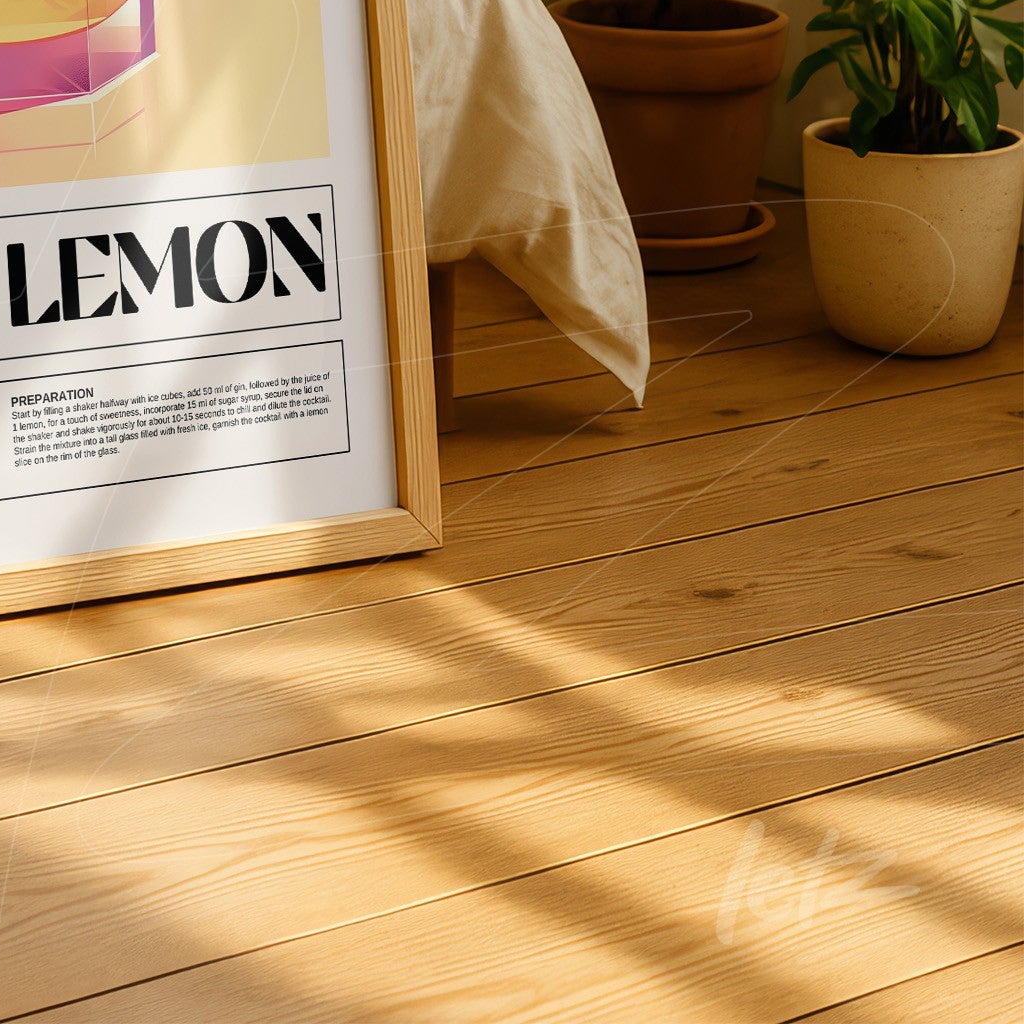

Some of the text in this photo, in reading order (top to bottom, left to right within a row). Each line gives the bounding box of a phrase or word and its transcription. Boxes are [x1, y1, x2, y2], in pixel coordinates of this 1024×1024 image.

[6, 212, 326, 327] LEMON
[11, 388, 94, 407] PREPARATION
[12, 410, 30, 419] Start
[33, 408, 41, 418] by
[44, 406, 63, 416] filling
[73, 402, 98, 411] shaker
[100, 397, 128, 408] halfway
[131, 394, 145, 404] with
[148, 393, 159, 402] ice
[160, 391, 185, 400] cubes,
[187, 388, 200, 398] add
[203, 387, 212, 395] 50
[214, 385, 223, 393] ml
[225, 383, 232, 392] of
[234, 382, 247, 393] gin,
[249, 377, 279, 389] followed
[281, 376, 289, 387] by
[291, 375, 302, 383] the
[304, 374, 320, 384] juice
[323, 372, 330, 380] of
[13, 395, 331, 443] the shaker and shake vigorously for about 10-15 seconds to chill and dilute the cocktail.
[20, 420, 46, 431] lemon,
[48, 418, 58, 427] for
[67, 414, 88, 424] touch
[90, 412, 98, 421] of
[100, 408, 141, 420] sweetness,
[143, 402, 185, 415] incorporate
[188, 400, 196, 408] 15
[199, 398, 207, 407] ml
[209, 397, 216, 406] of
[219, 397, 238, 407] sugar
[241, 393, 263, 403] syrup,
[265, 389, 289, 399] secure
[291, 387, 302, 395] the
[14, 444, 37, 455] Strain
[39, 442, 51, 451] the
[53, 438, 81, 449] mixture
[83, 436, 97, 445] into
[106, 433, 117, 442] tall
[119, 431, 138, 443] glass
[141, 427, 158, 438] filled
[160, 424, 175, 435] with
[177, 423, 195, 433] fresh
[197, 421, 210, 431] ice,
[212, 418, 239, 431] garnish
[241, 416, 252, 424] the
[255, 411, 281, 423] cocktail
[283, 409, 298, 419] with
[307, 406, 328, 416] lemon
[15, 446, 119, 467] slice on the rim of the glass.
